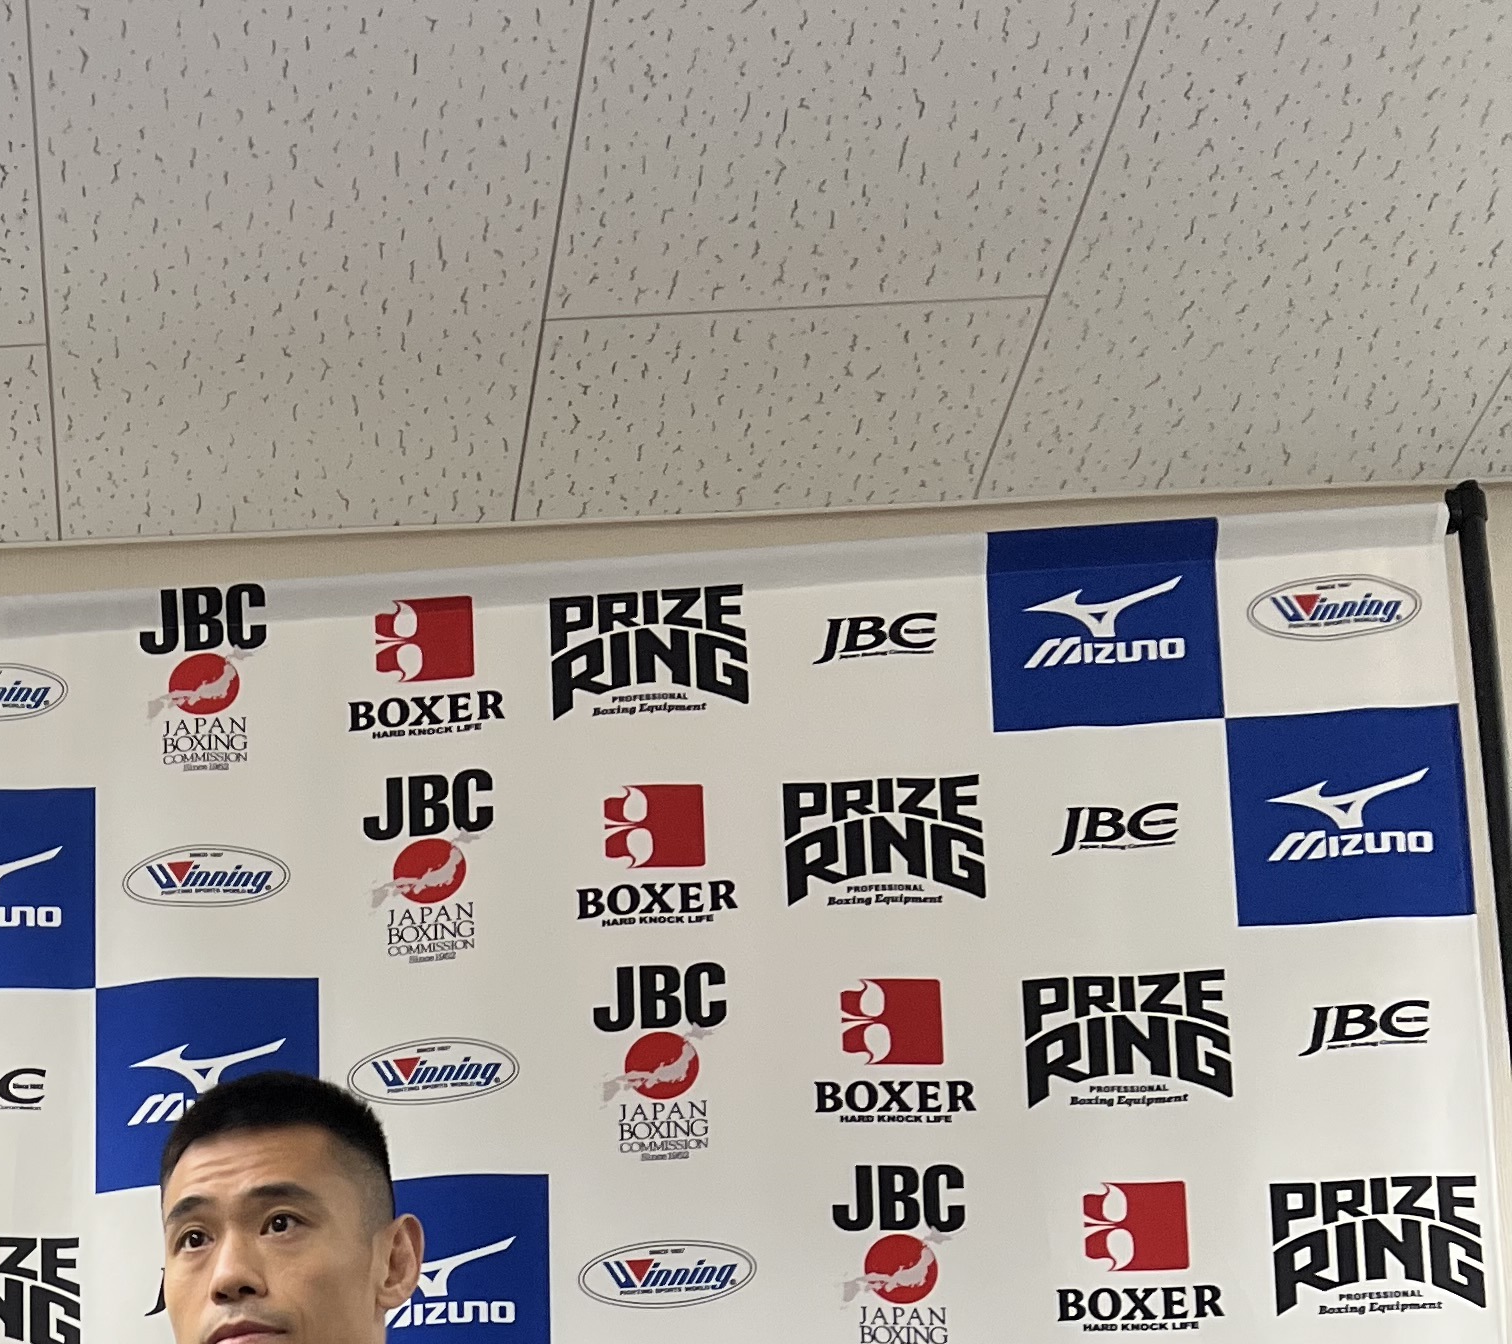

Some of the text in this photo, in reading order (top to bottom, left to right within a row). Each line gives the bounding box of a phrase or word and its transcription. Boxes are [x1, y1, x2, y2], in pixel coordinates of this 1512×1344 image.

[140, 583, 266, 654] JBC
[549, 584, 746, 656] PRIZE
[552, 628, 749, 720] RING
[1024, 637, 1184, 668] MIZUNO
[783, 774, 983, 840] PRIZE
[785, 816, 986, 906] RING
[1269, 831, 1433, 861] MIZUNO
[577, 880, 738, 919] BOXER
[827, 894, 943, 906] Boxing Equipment
[847, 884, 924, 893] PROFESSIONAL
[593, 962, 726, 1032] JBC
[1022, 969, 1229, 1041] PRIZE
[1298, 1000, 1429, 1056] JBC
[1026, 1015, 1233, 1109] RING
[814, 1081, 976, 1113] BOXER
[832, 1164, 965, 1232] JBC
[1269, 1176, 1481, 1246] PRIZE
[603, 1259, 738, 1290] Winning
[1273, 1218, 1486, 1316] RING
[1056, 1285, 1224, 1321] BOXER
